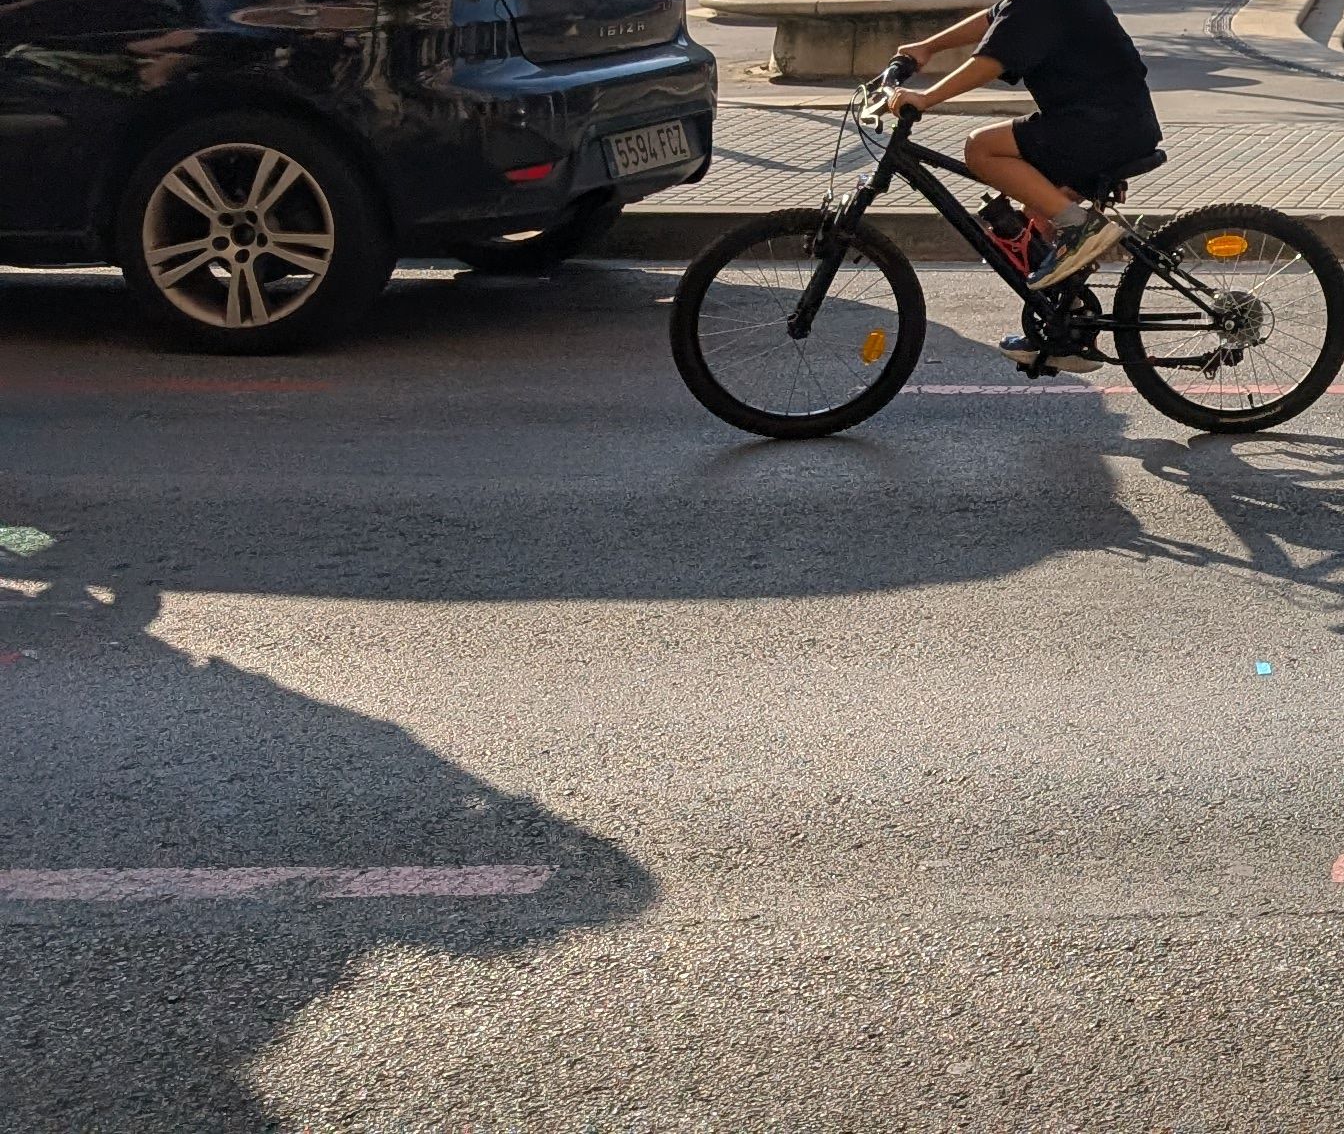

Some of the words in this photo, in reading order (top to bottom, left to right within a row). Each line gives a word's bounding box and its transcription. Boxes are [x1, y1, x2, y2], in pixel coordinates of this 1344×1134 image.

[600, 22, 646, 38] IBIZA
[614, 132, 658, 168] 5594
[656, 123, 687, 161] FCZ
